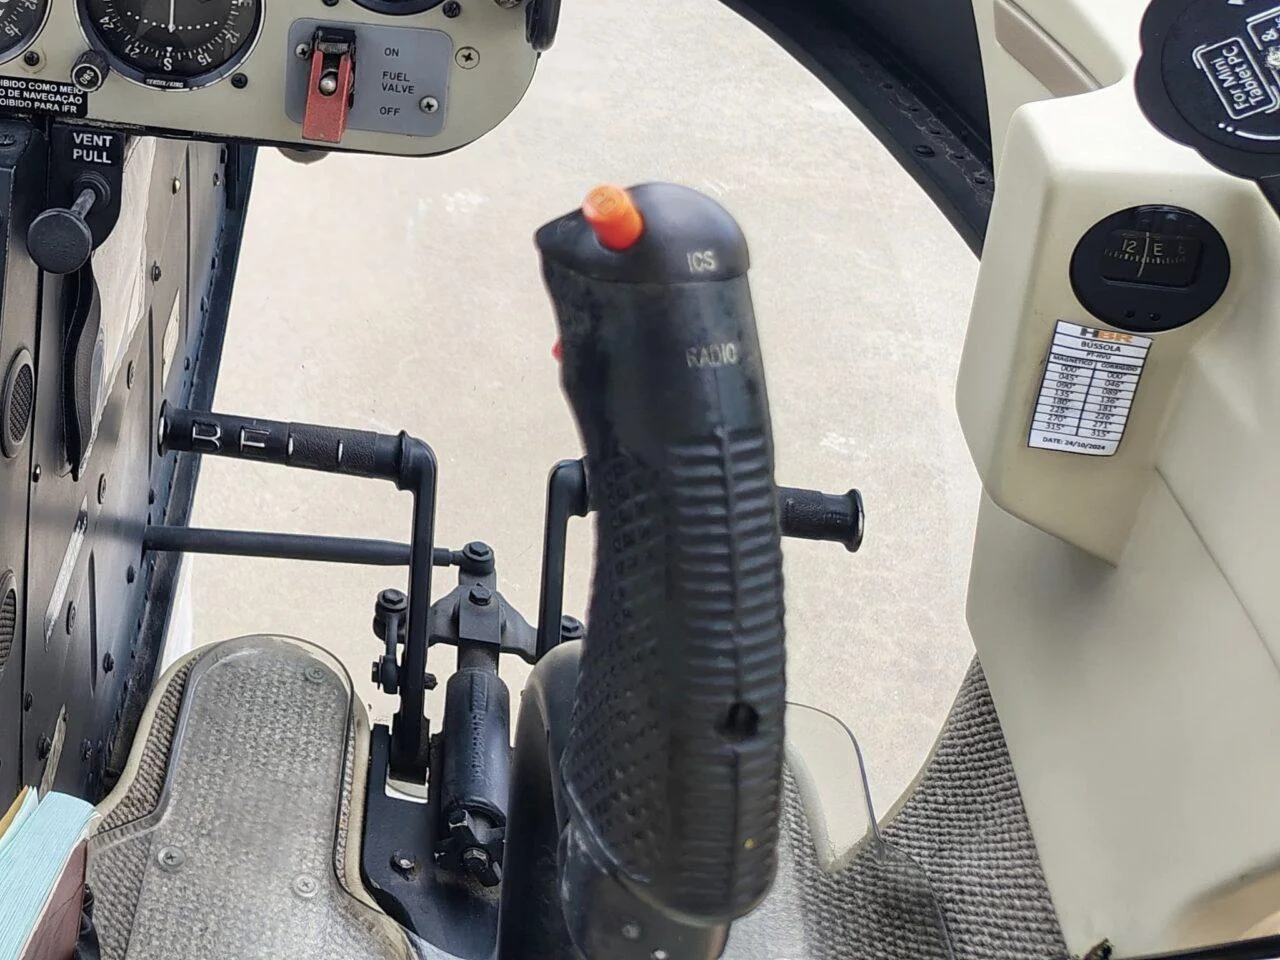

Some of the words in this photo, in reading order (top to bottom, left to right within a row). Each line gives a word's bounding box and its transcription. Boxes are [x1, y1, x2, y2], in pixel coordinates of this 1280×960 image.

[385, 48, 399, 57] ON
[1222, 46, 1243, 65] PC
[80, 70, 94, 84] OBS
[383, 72, 409, 82] FUEL
[1210, 58, 1237, 87] Mini
[28, 83, 57, 92] COMO
[59, 86, 83, 95] MEIO
[382, 83, 414, 94] VALVE
[1235, 65, 1265, 105] Tablet
[23, 92, 82, 105] NAVEGAÇÃO
[1234, 90, 1249, 109] For
[34, 102, 59, 111] PARA
[62, 104, 76, 113] IFR
[380, 107, 400, 116] OFF
[73, 133, 113, 147] VENT
[73, 149, 112, 163] PULL
[686, 251, 715, 273] ICS
[1081, 341, 1121, 352] BUSSOLA
[686, 343, 737, 367] RADIO
[1064, 440, 1105, 450] 24/10/2024
